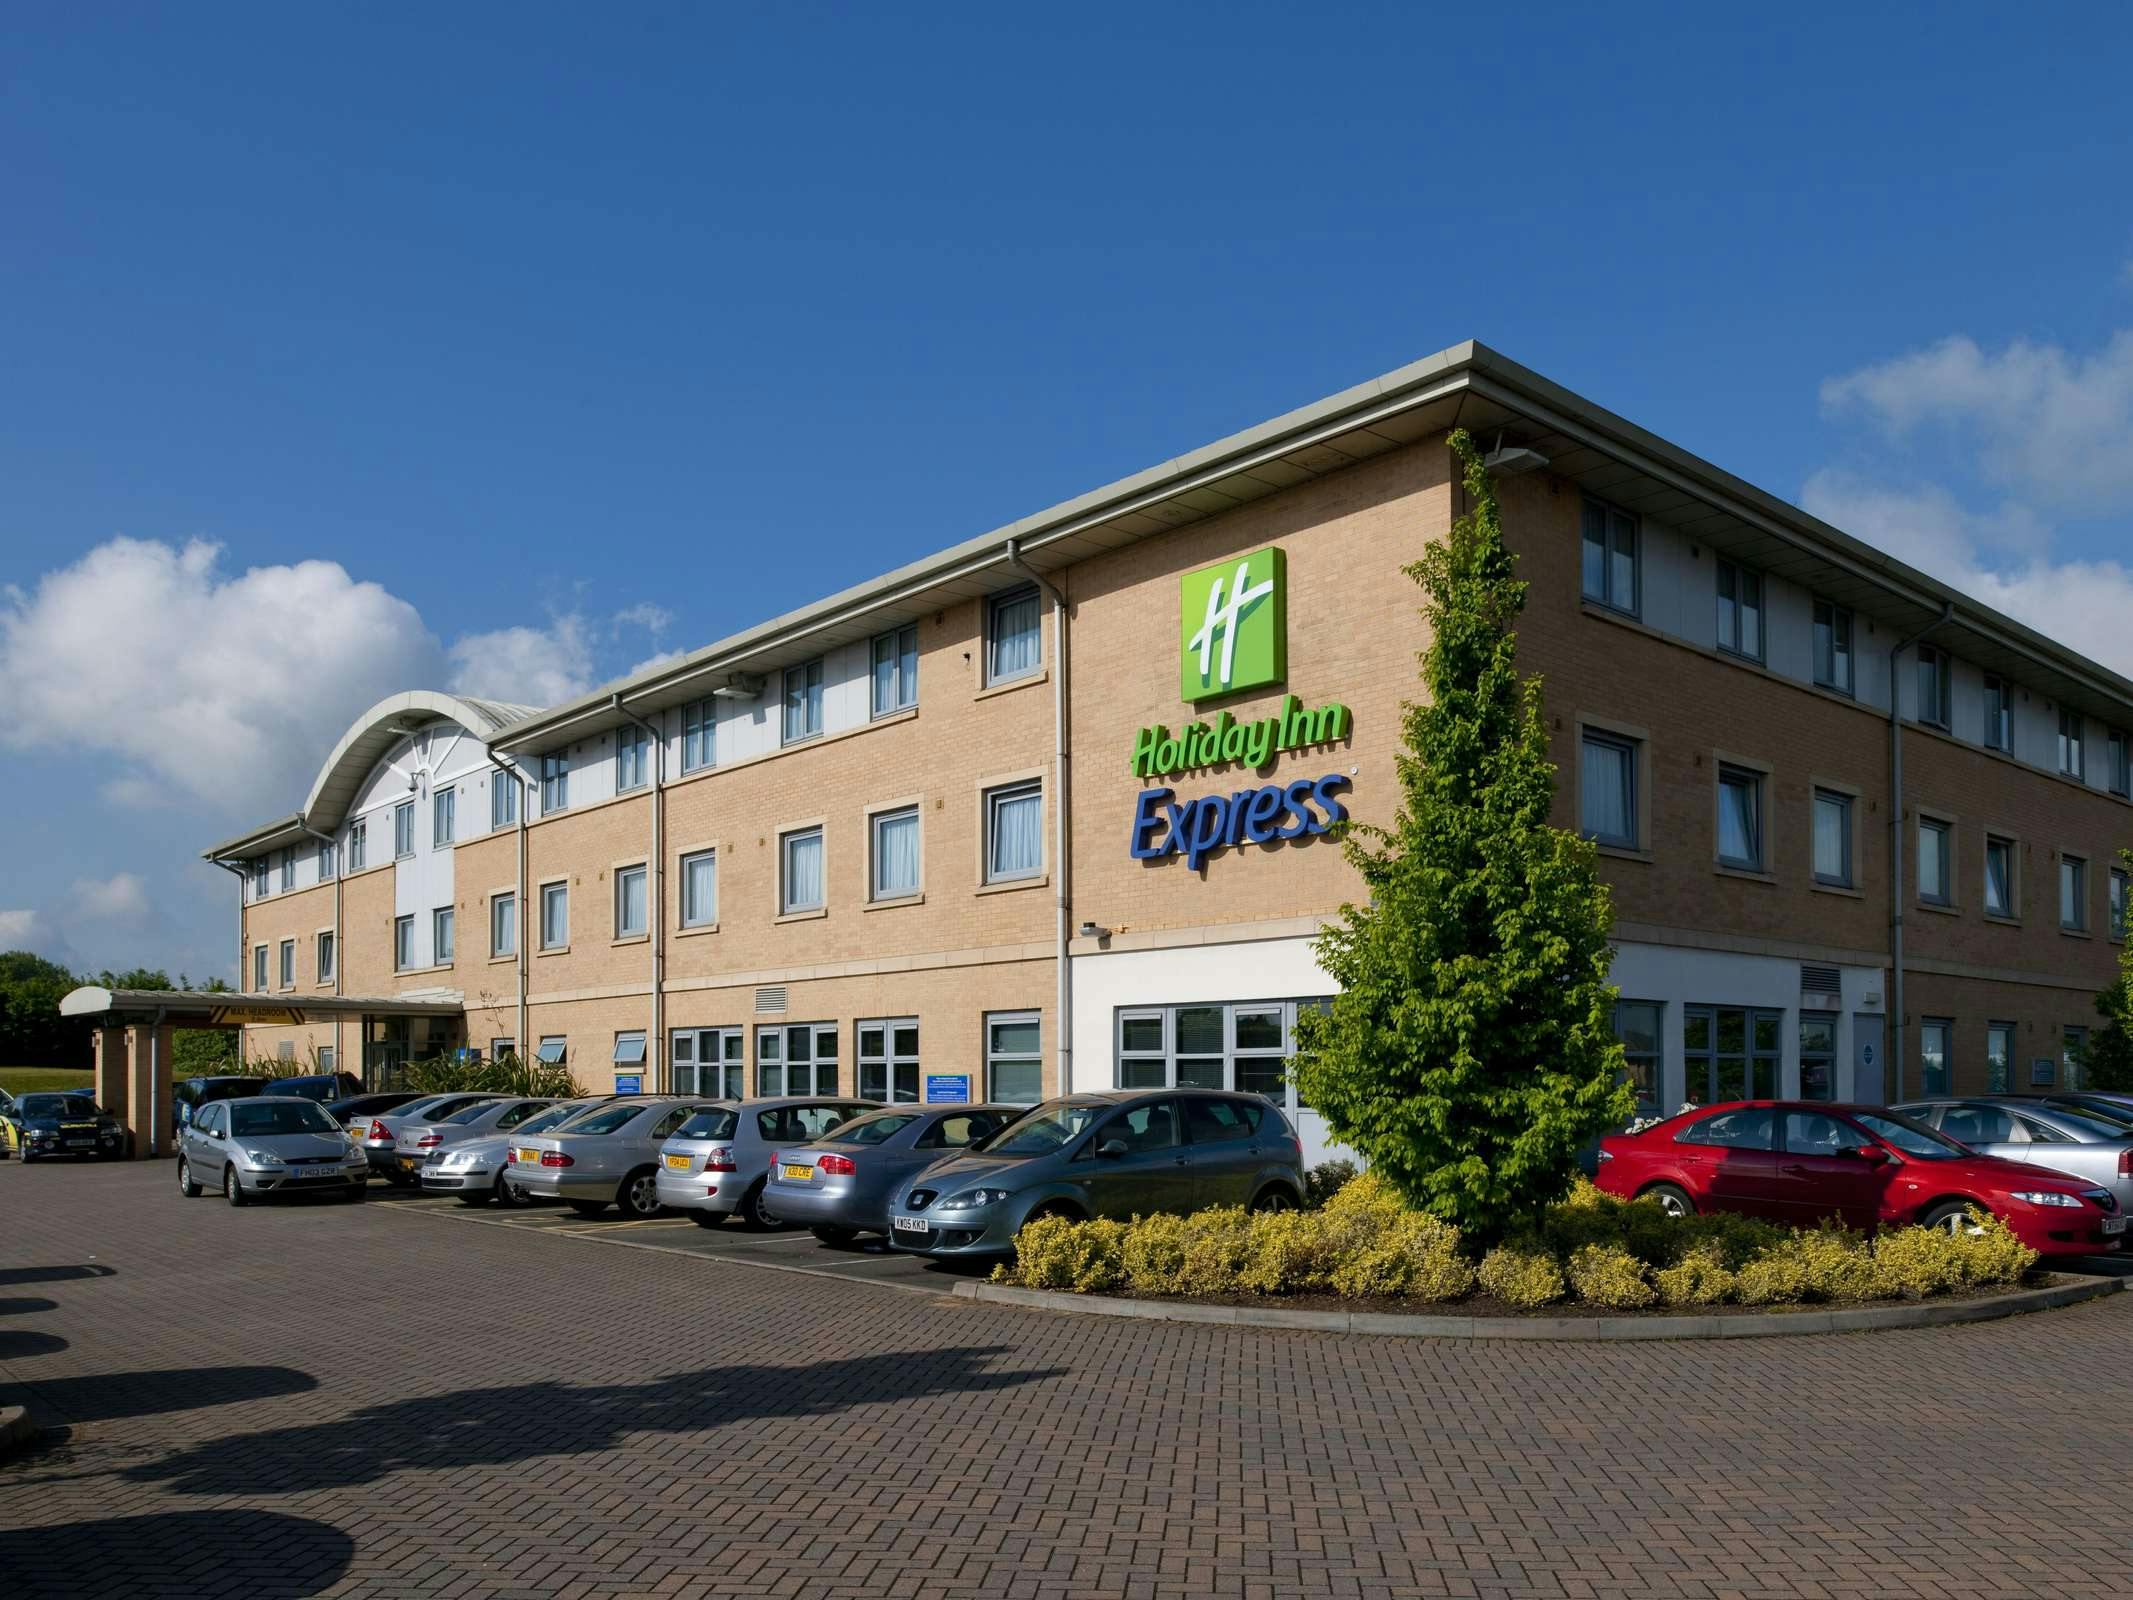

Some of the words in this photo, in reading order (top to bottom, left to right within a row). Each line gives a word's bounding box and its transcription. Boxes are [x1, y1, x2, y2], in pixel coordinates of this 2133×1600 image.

[1131, 711, 1280, 778] Holiday
[1278, 694, 1351, 749] Inn
[1130, 773, 1352, 872] Express
